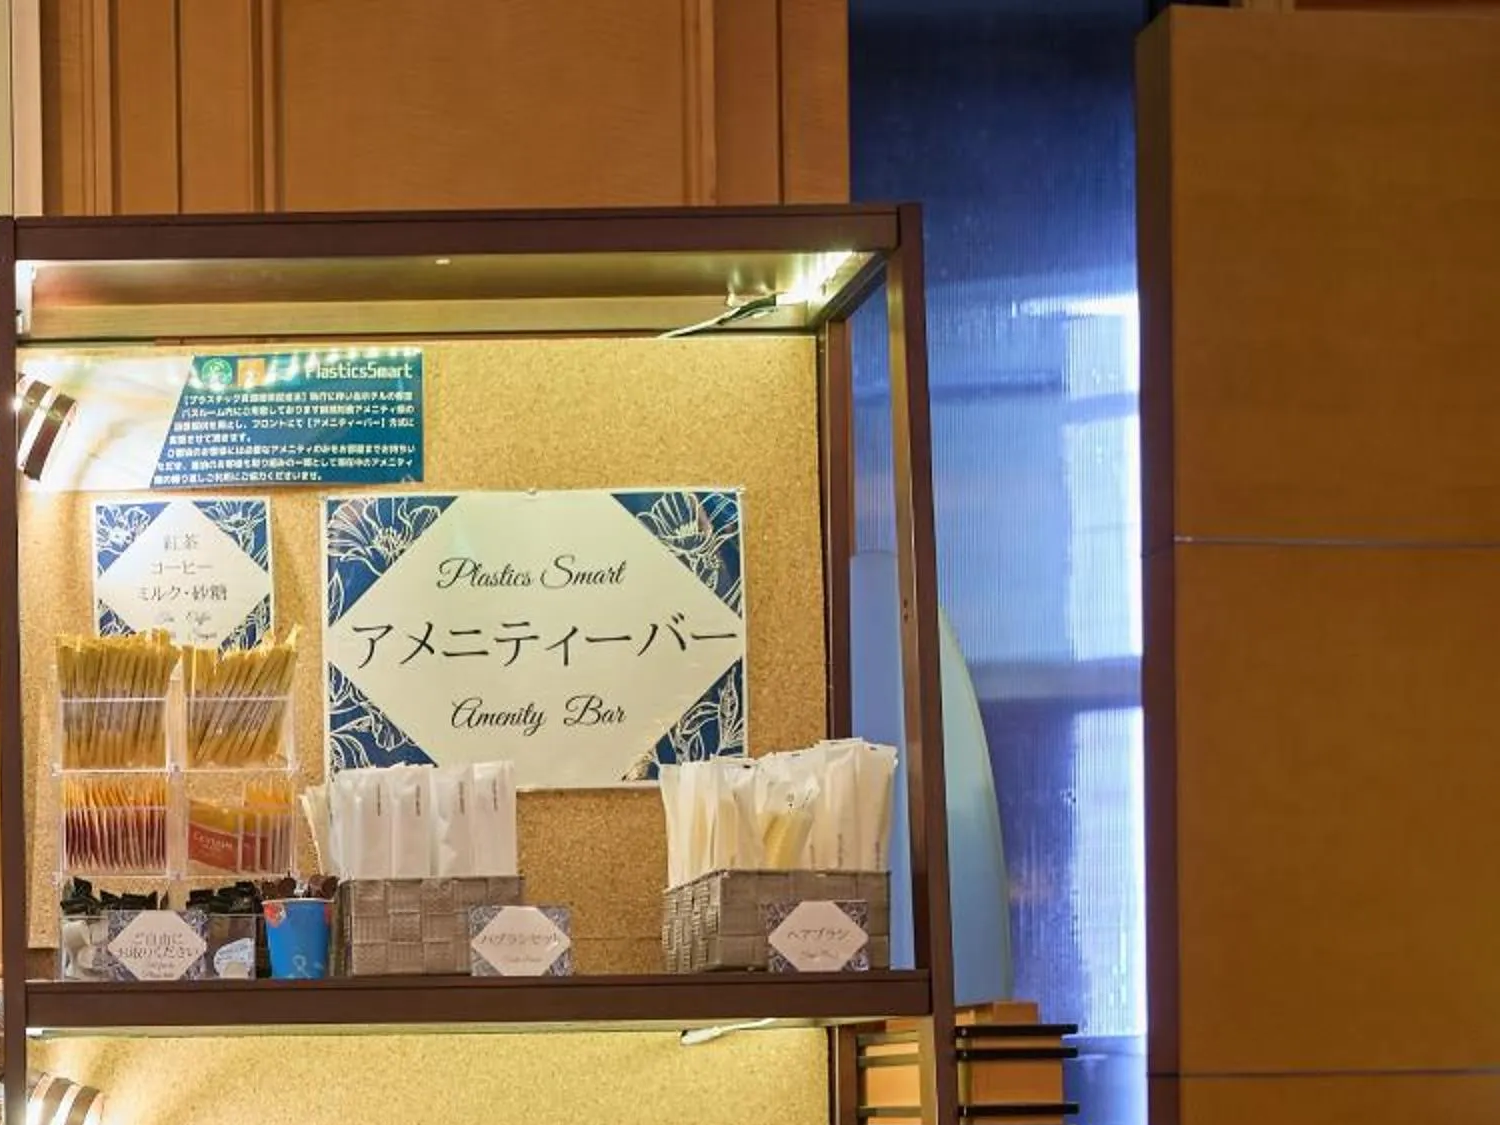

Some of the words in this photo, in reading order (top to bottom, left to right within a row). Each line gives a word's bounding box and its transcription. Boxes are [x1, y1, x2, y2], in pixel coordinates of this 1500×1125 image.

[164, 533, 198, 551] 紅茶
[150, 560, 214, 576] コーヒー
[437, 557, 533, 590] Plastics
[540, 554, 627, 589] Smart
[139, 584, 228, 602] ミルク・砂糖
[350, 611, 739, 670] アメニティーバー
[451, 697, 546, 737] Amenity
[563, 694, 627, 727] Bar
